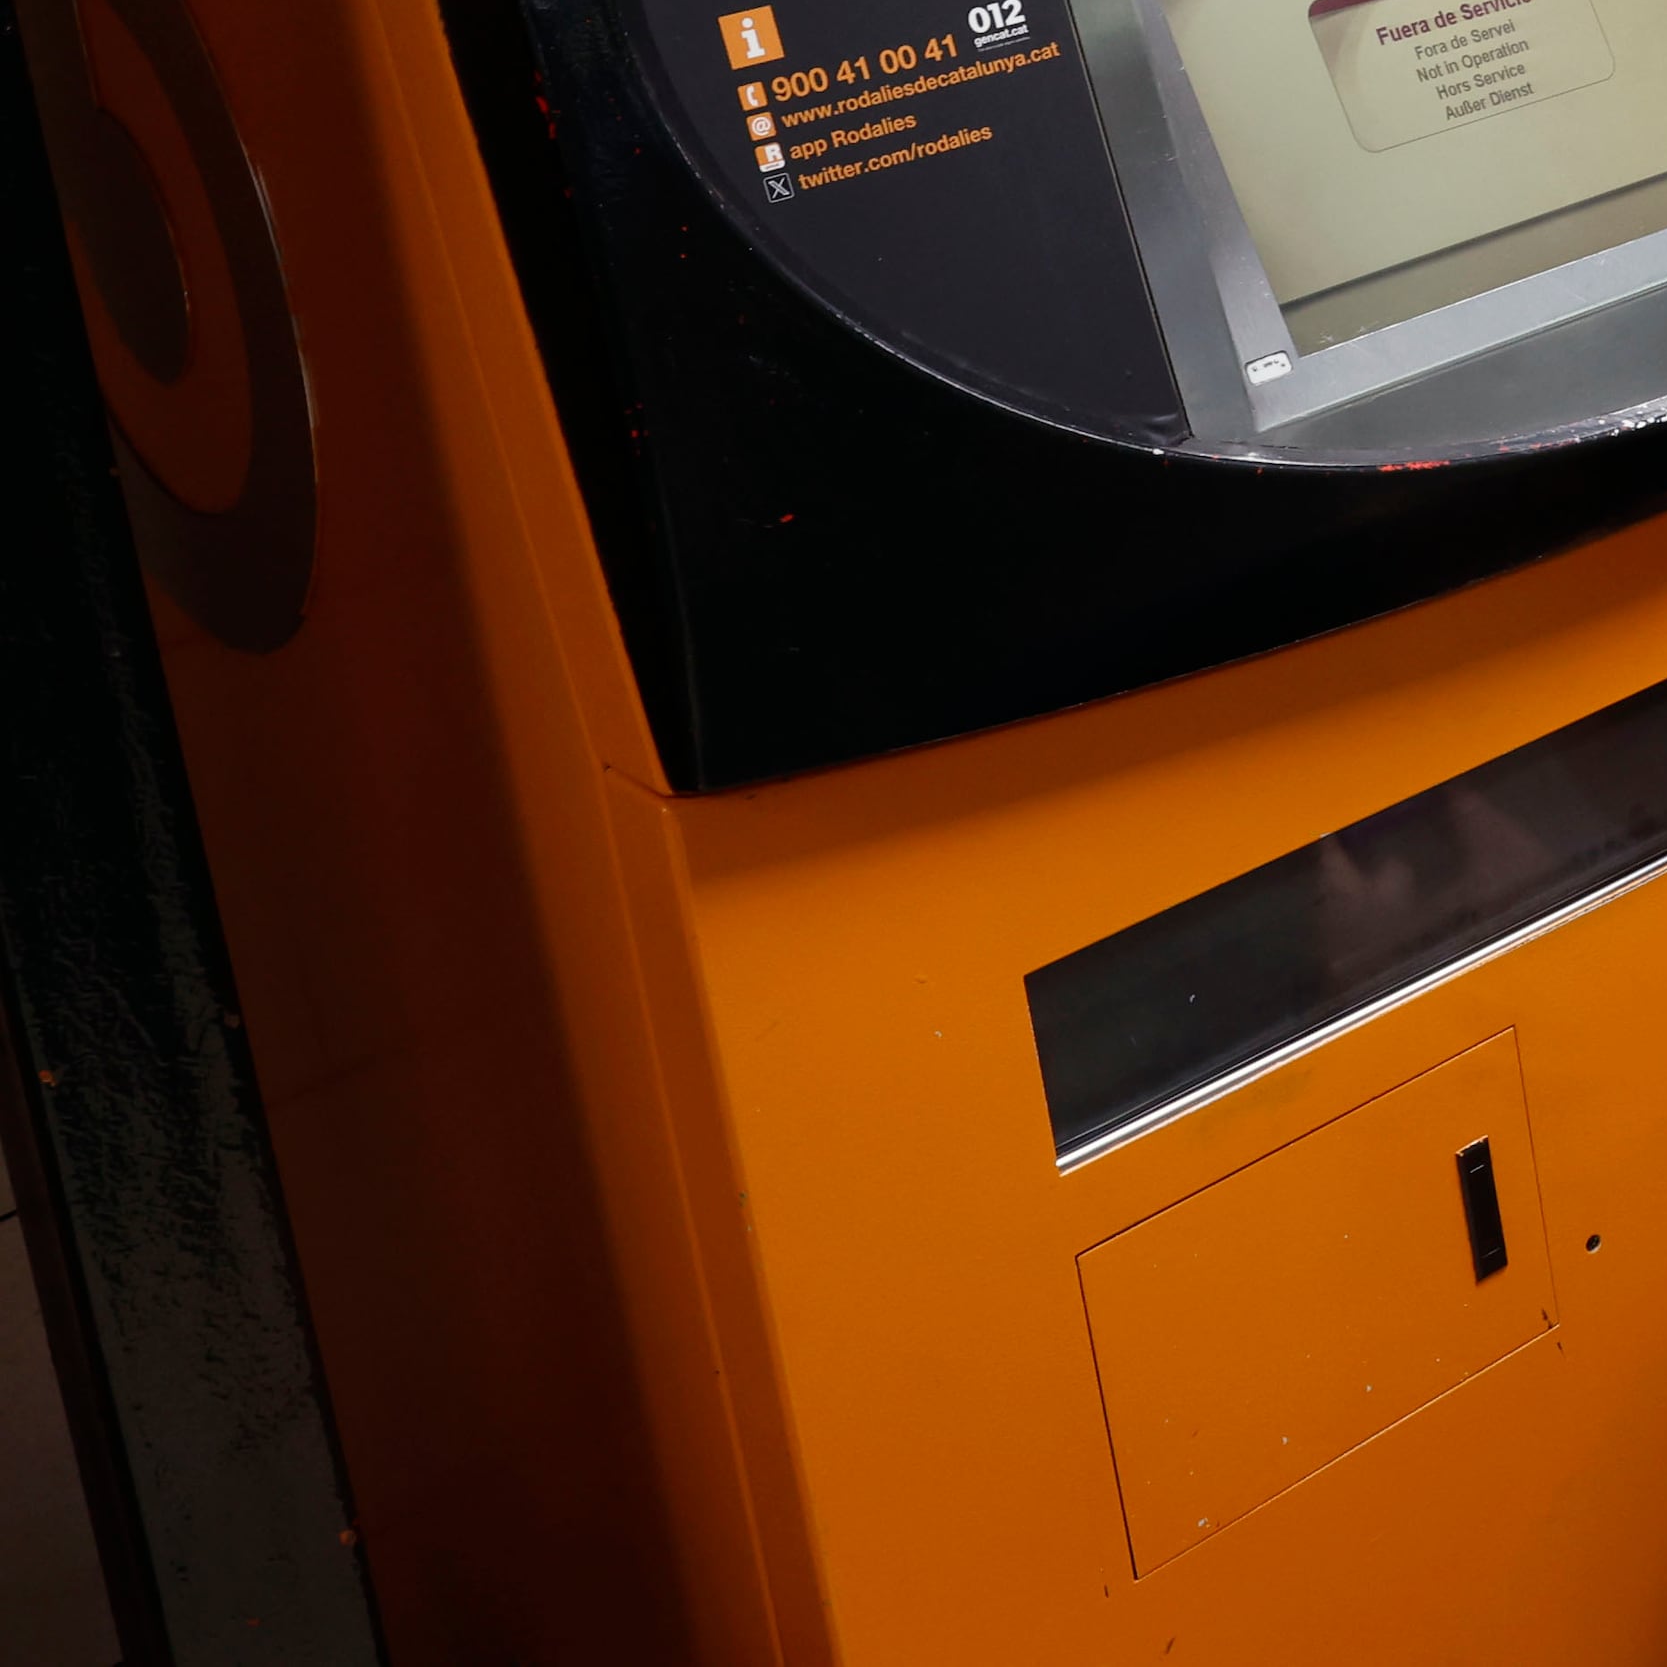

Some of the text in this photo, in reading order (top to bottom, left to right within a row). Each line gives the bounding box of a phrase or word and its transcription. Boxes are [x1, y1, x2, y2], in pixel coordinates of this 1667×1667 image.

[973, 24, 1029, 48] gencat.cat
[1375, 15, 1432, 46] Fuera
[1433, 10, 1458, 30] de
[1414, 18, 1516, 60] Fora de Servei
[771, 67, 829, 102] 900
[836, 54, 872, 85] 41
[879, 43, 919, 75] 00
[924, 33, 959, 64] 41
[1415, 37, 1530, 83] Not in Operation
[1435, 62, 1526, 100] Hors Service
[781, 41, 1061, 130] www.rodaliesdecatalunya.cat
[1445, 81, 1535, 121] Außer Dienst
[789, 112, 918, 162] app Rodalies
[797, 124, 993, 191] twitter.com/rodalies
